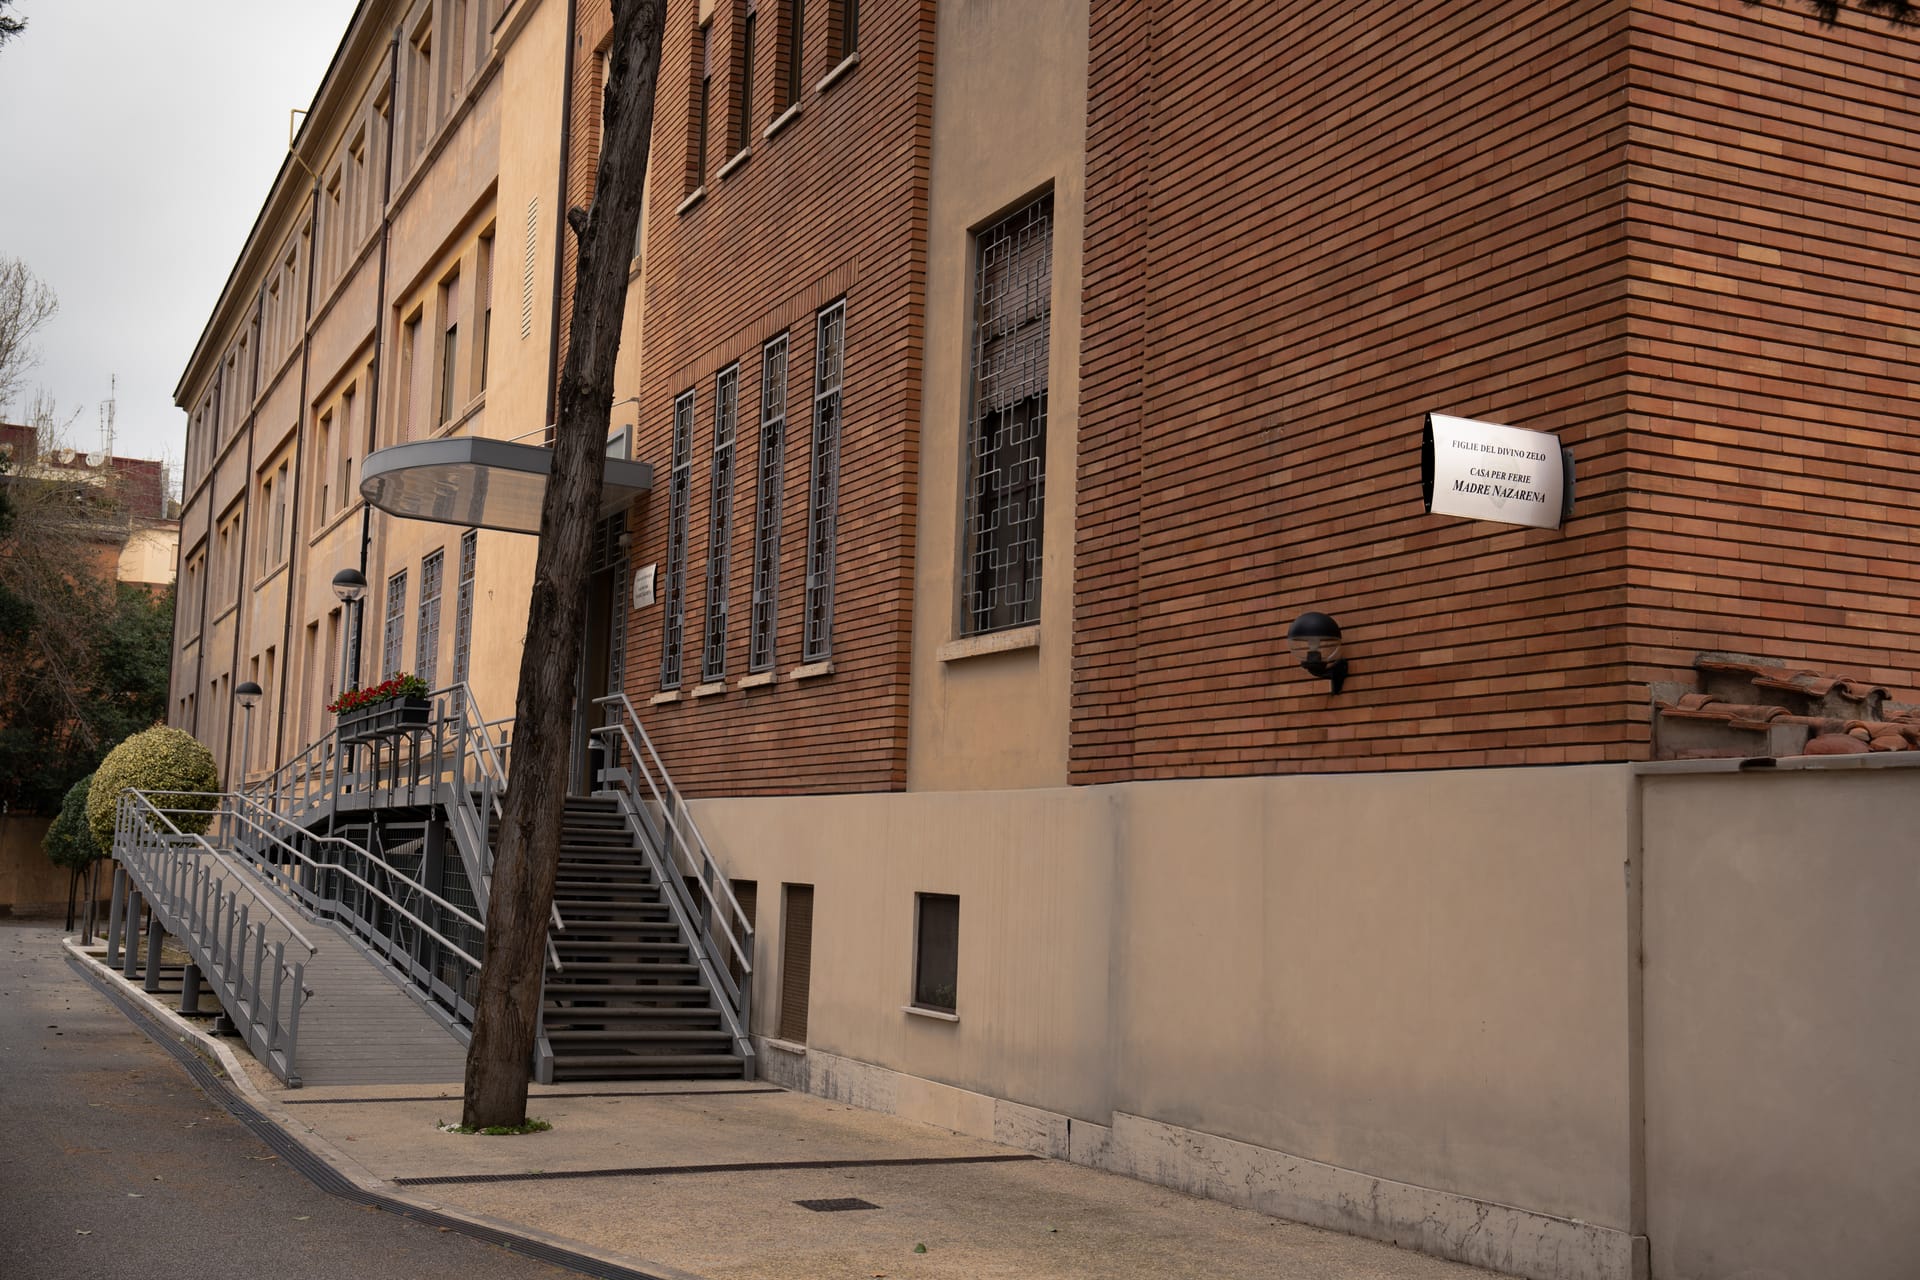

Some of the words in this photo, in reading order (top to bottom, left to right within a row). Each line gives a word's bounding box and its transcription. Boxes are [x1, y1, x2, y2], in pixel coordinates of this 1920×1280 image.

[1452, 440, 1479, 451] FIGLIE
[1480, 442, 1496, 455] DEL
[1497, 447, 1524, 458] DIVINO
[1526, 451, 1546, 462] ZELO
[1470, 467, 1490, 478] CASA
[1491, 470, 1507, 481] PER
[1507, 473, 1531, 484] FERIE
[1452, 479, 1491, 496] MADRE
[1492, 485, 1546, 503] NAZARENA
